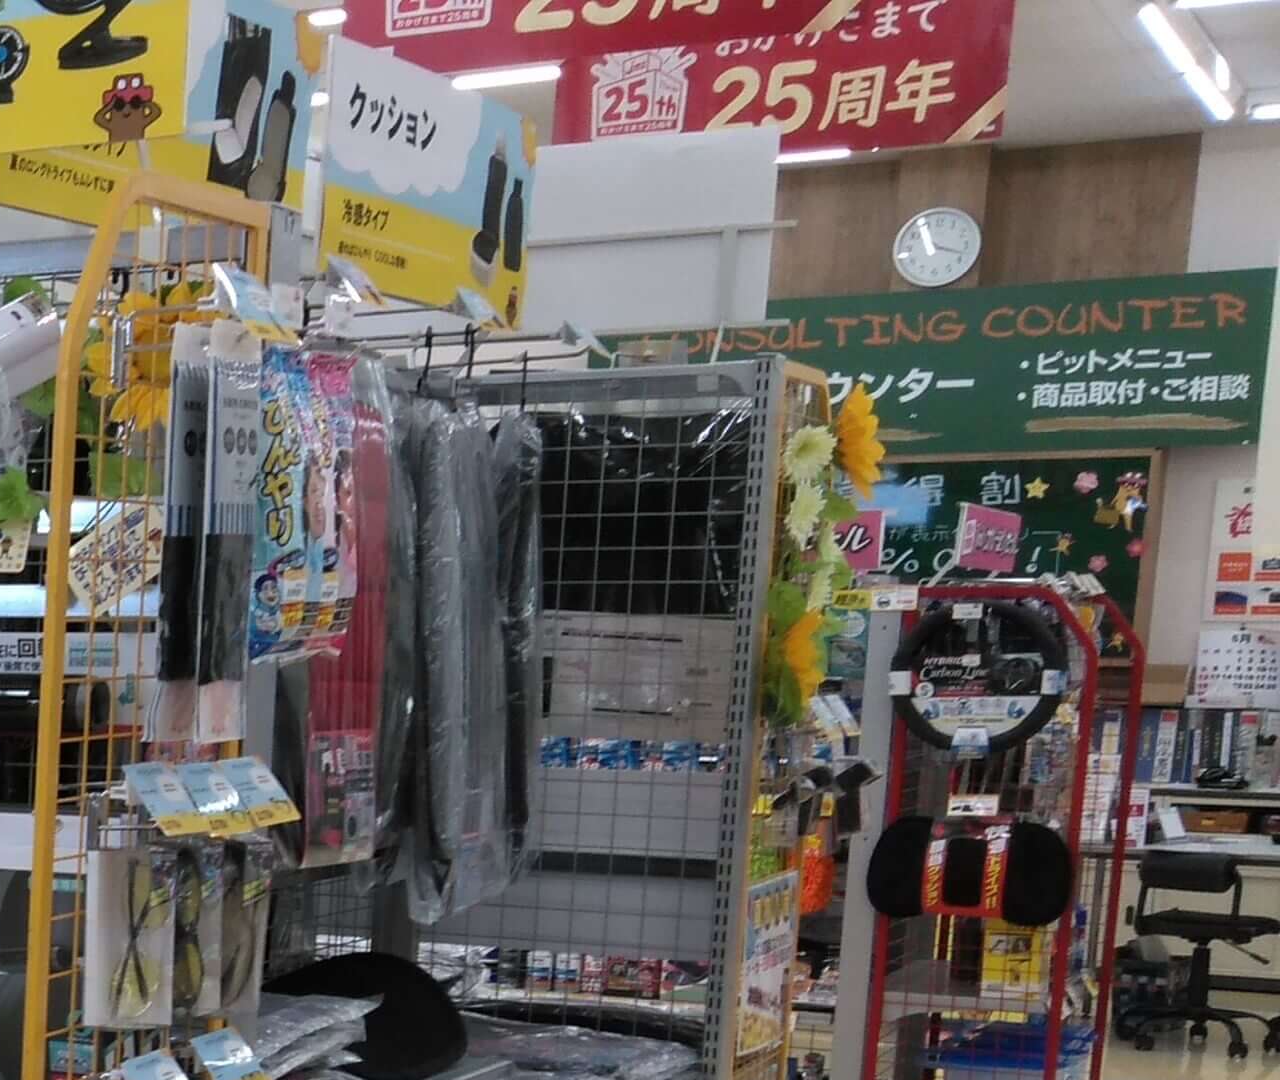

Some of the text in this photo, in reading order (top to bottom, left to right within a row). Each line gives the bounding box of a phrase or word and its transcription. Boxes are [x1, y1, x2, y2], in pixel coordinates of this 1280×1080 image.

[349, 81, 437, 151] クッション
[704, 58, 956, 135] 25周年
[342, 199, 389, 231] 冷感タイプ
[982, 292, 1248, 338] COUNTER
